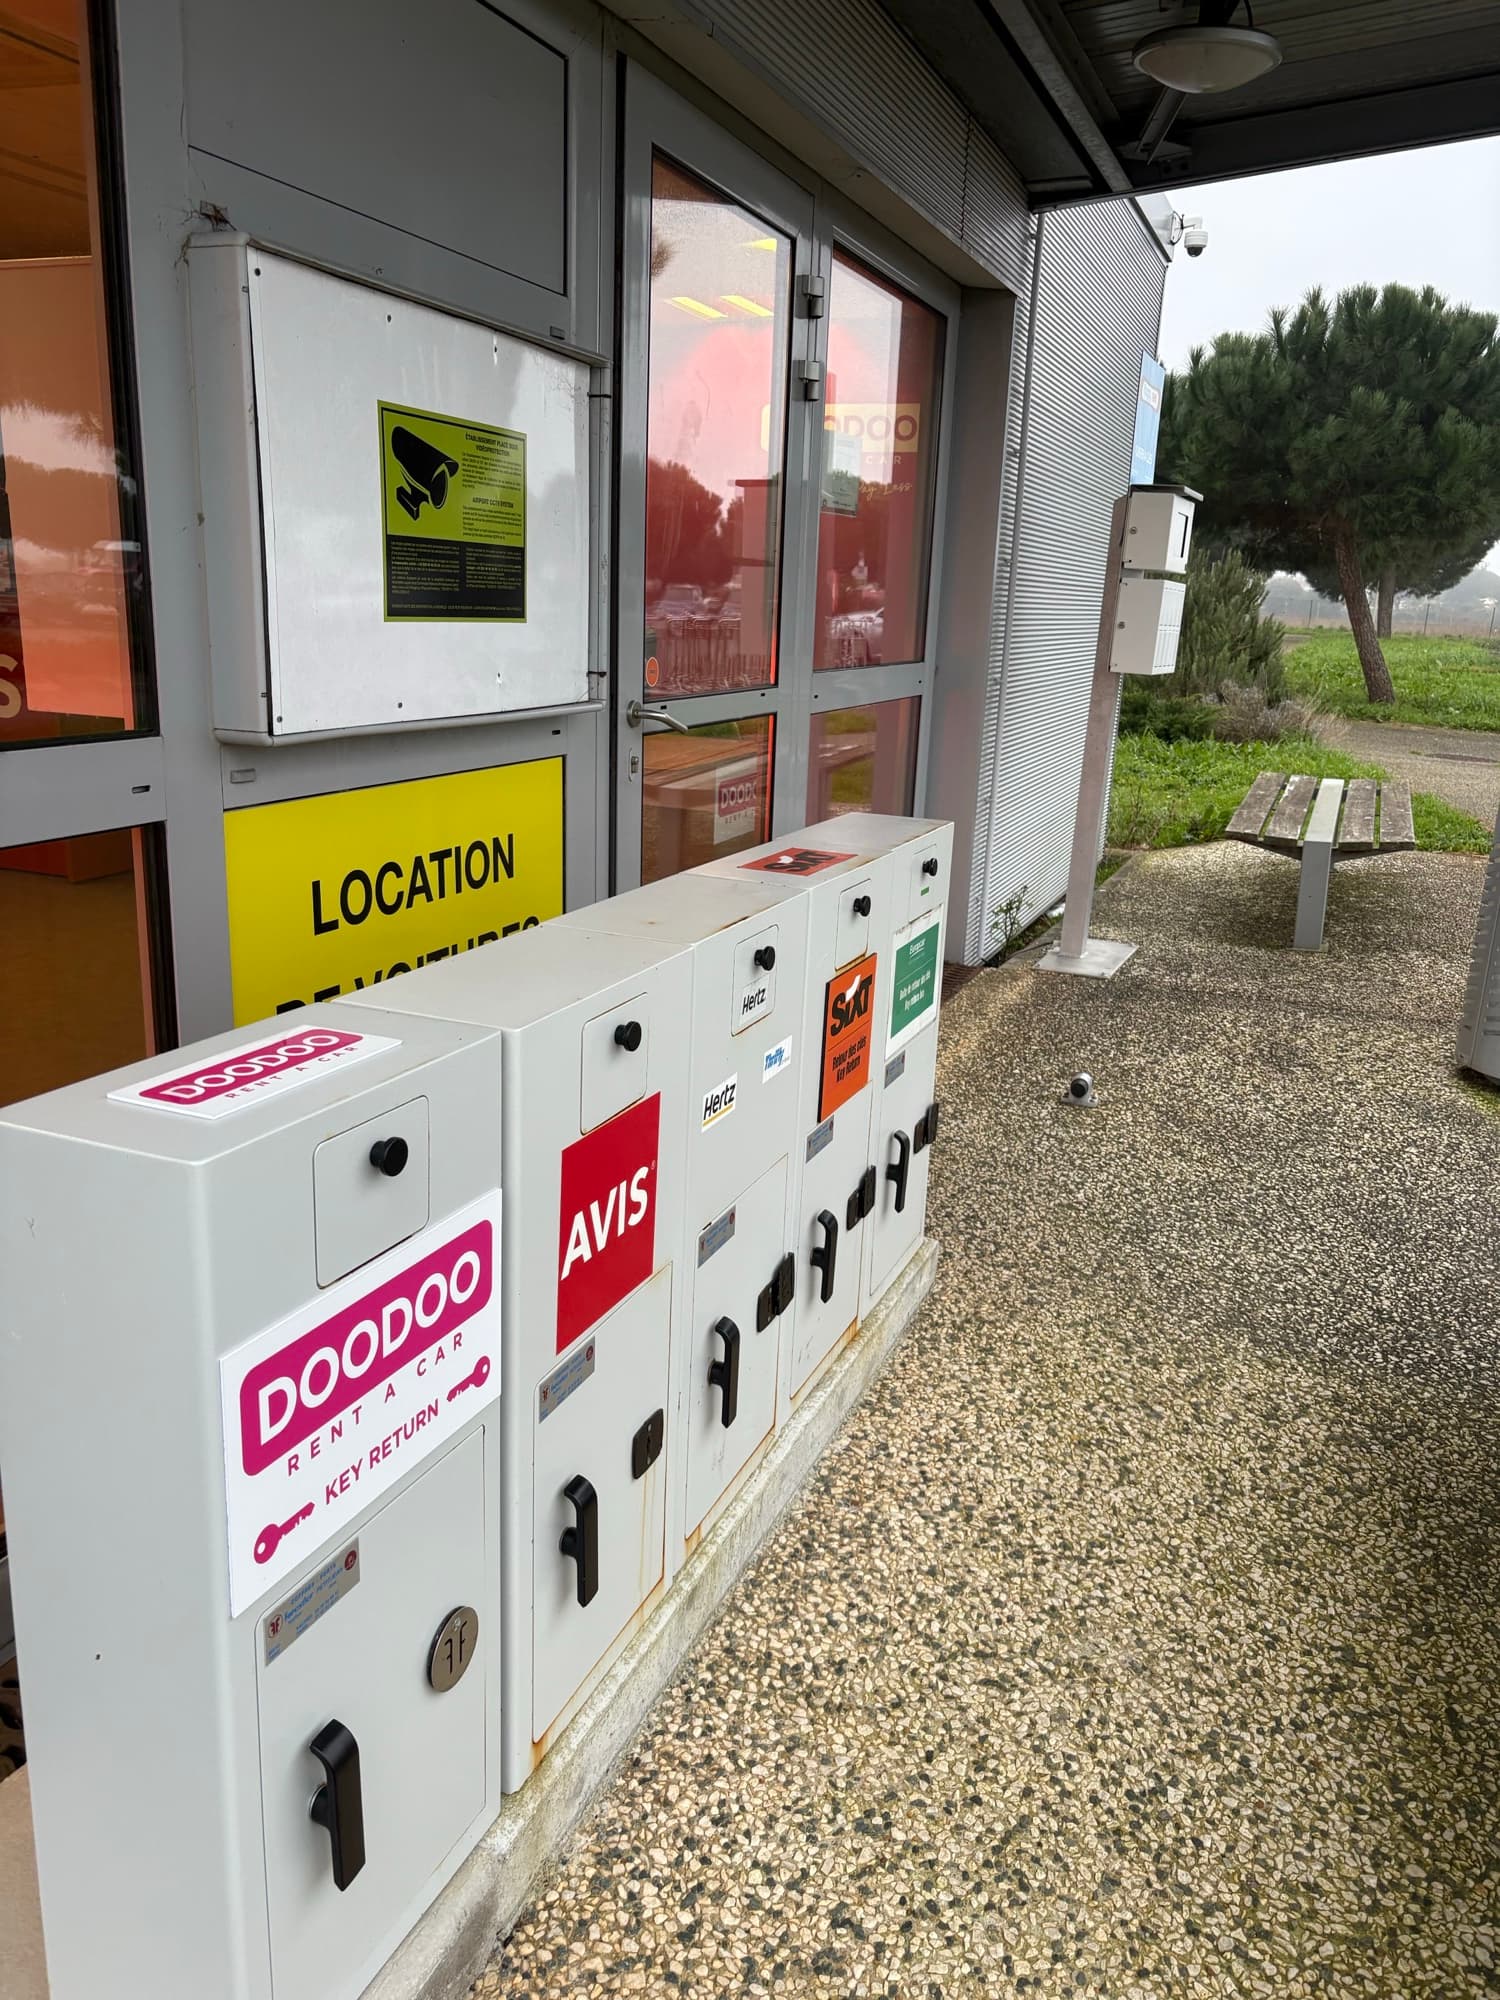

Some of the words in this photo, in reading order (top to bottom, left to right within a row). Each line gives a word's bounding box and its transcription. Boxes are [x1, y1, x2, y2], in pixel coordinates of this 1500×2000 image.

[311, 833, 514, 936] LOCATION
[742, 987, 766, 1016] Hertz
[831, 974, 873, 1036] SIXT
[159, 1034, 340, 1099] DOODOO
[225, 1075, 282, 1099] RENT
[318, 1046, 359, 1062] CAR
[836, 1066, 846, 1083] Key
[703, 1083, 737, 1121] Hertz
[561, 1166, 650, 1281] AVIS
[257, 1249, 481, 1447] DOODOO
[287, 1405, 362, 1477] RENT
[384, 1386, 396, 1404] A
[416, 1331, 465, 1377] CAR
[325, 1458, 364, 1505] KEY
[369, 1397, 439, 1472] RETURN
